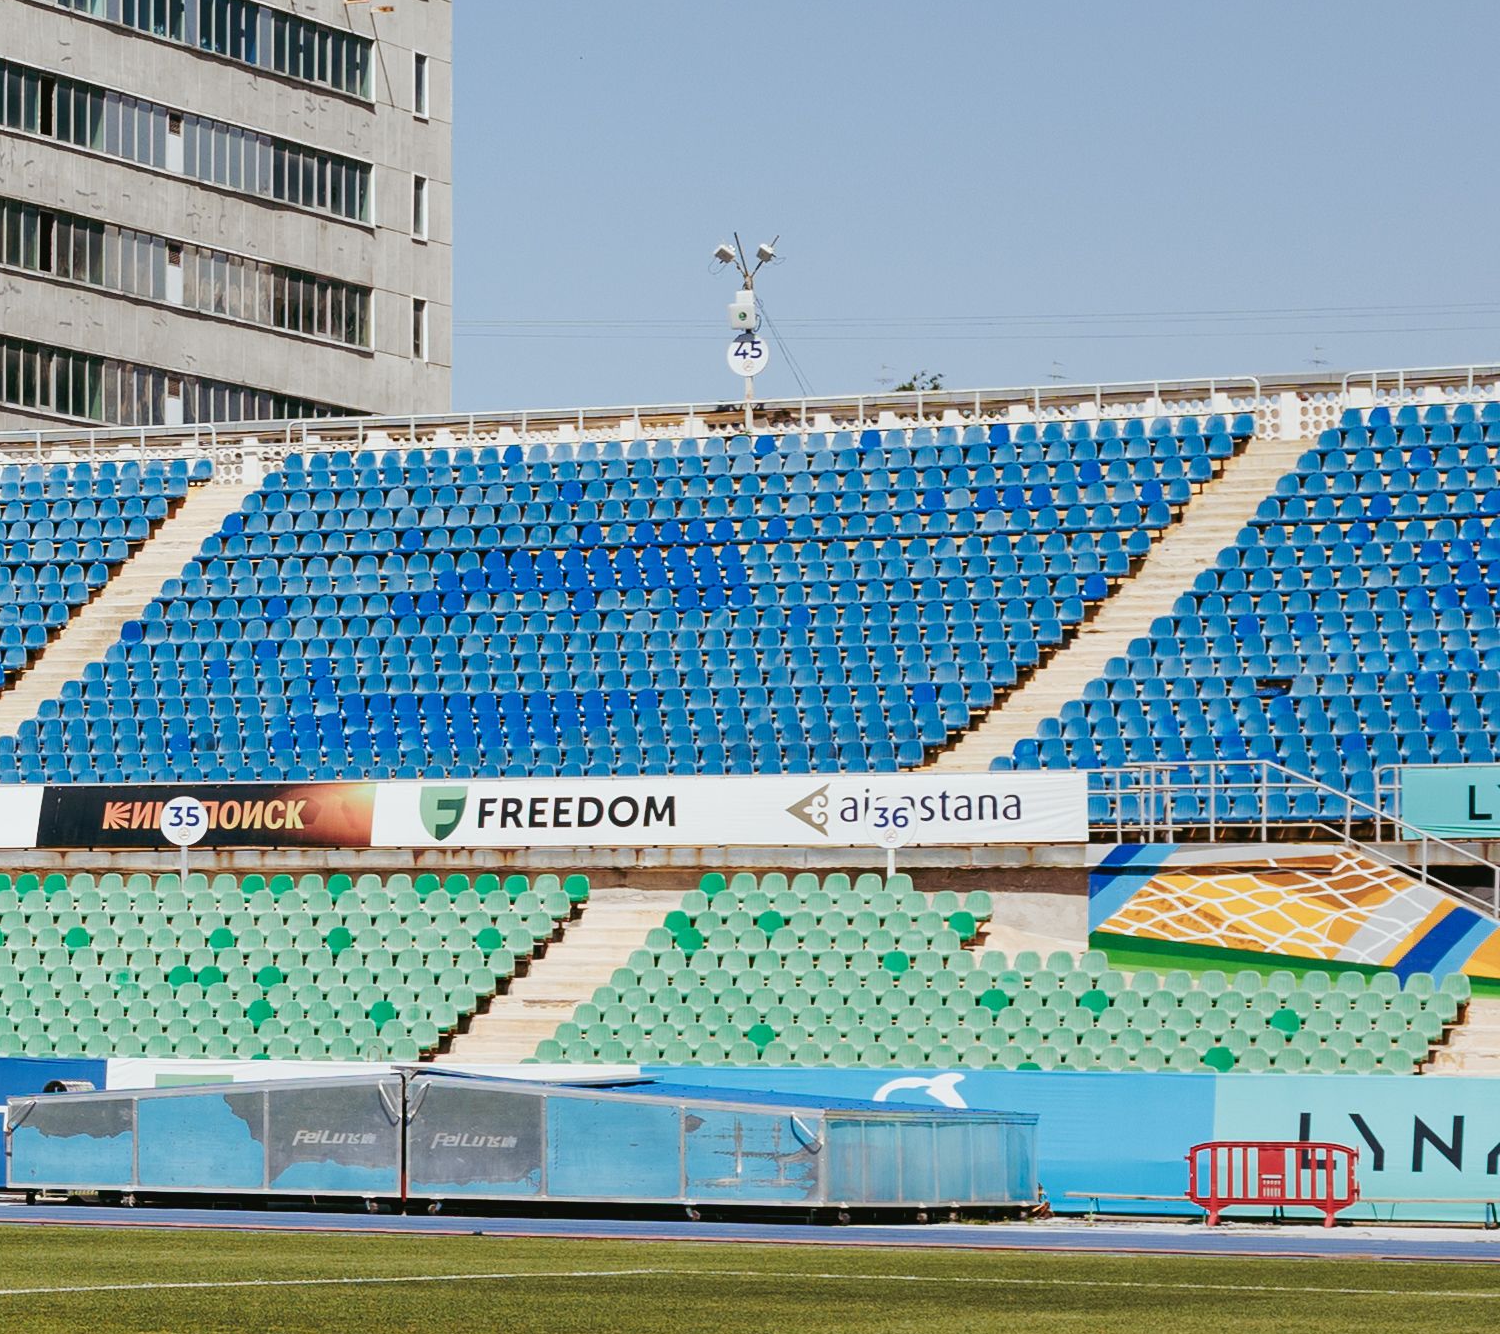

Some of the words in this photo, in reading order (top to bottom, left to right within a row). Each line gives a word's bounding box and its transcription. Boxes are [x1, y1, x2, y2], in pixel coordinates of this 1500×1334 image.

[734, 340, 763, 359] 45
[102, 799, 307, 830] КИПОИСК
[168, 806, 200, 827] 35
[477, 795, 677, 829] FREEDOM
[840, 788, 888, 823] ai
[873, 806, 909, 829] 36
